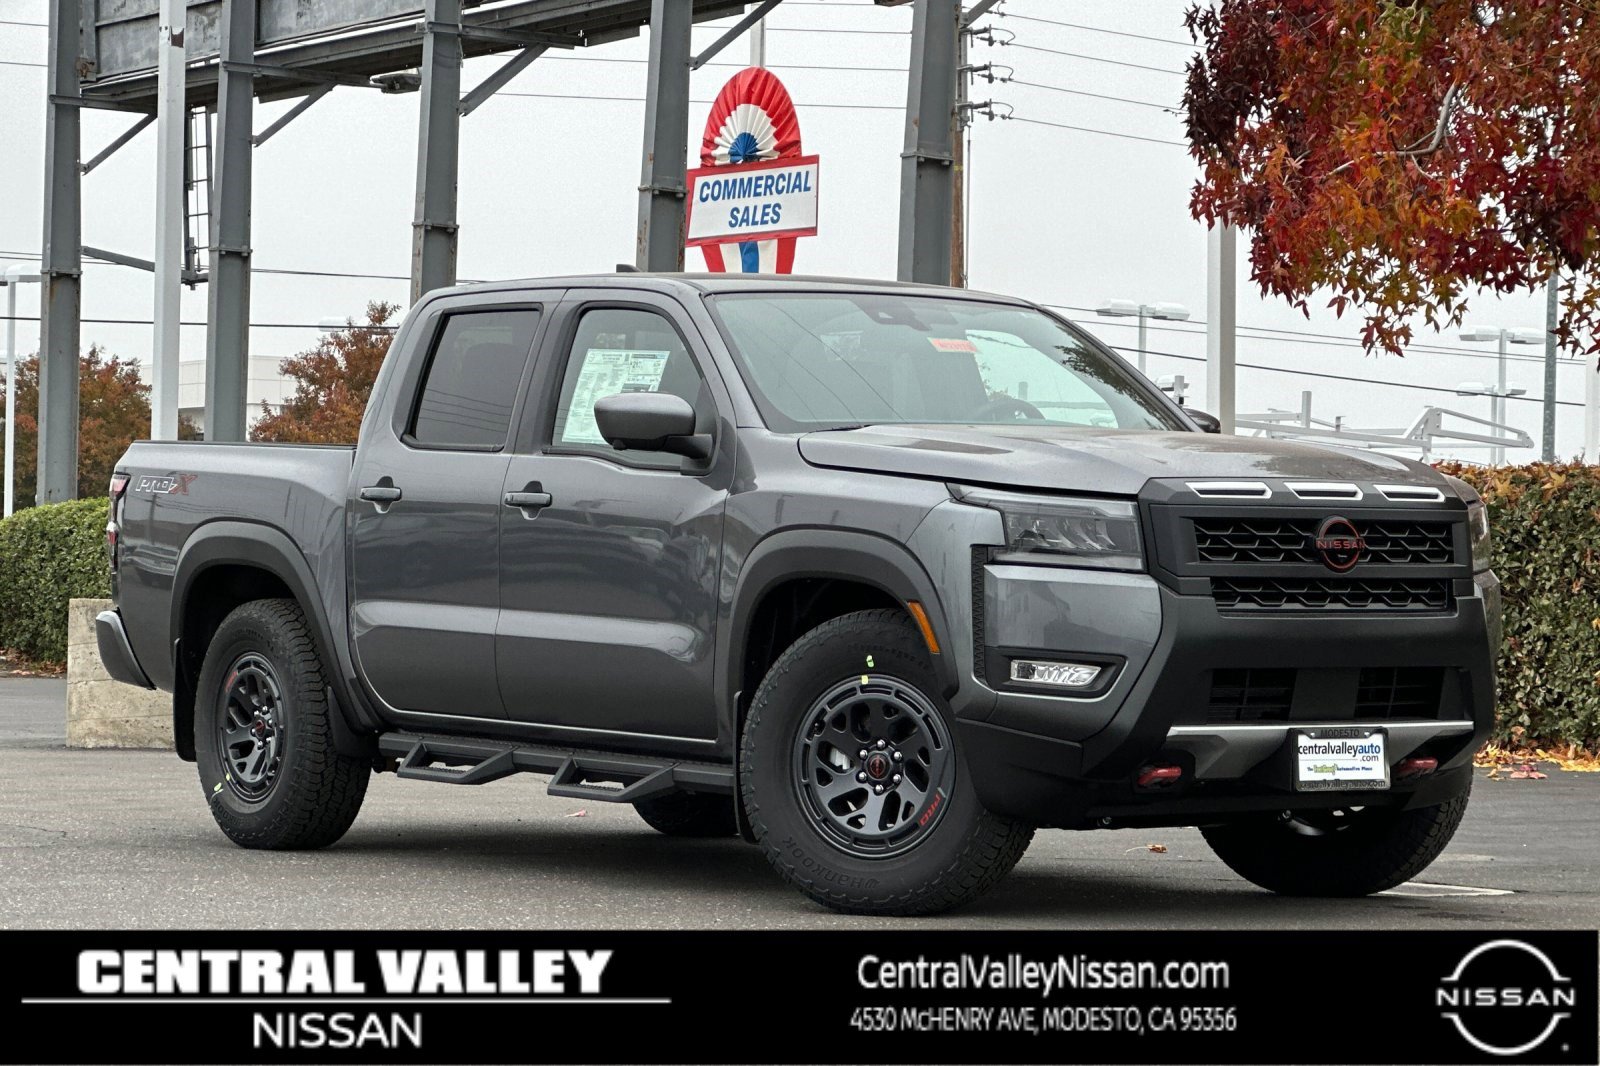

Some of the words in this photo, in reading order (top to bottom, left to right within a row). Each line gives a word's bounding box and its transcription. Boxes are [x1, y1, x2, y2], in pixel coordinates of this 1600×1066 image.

[699, 170, 811, 203] COMMERCIAL
[728, 202, 782, 229] SALES
[1316, 540, 1366, 549] NISSAN
[1320, 728, 1360, 738] MODESTO
[1298, 741, 1381, 758] centralvalleyauto
[1359, 754, 1380, 762] .com
